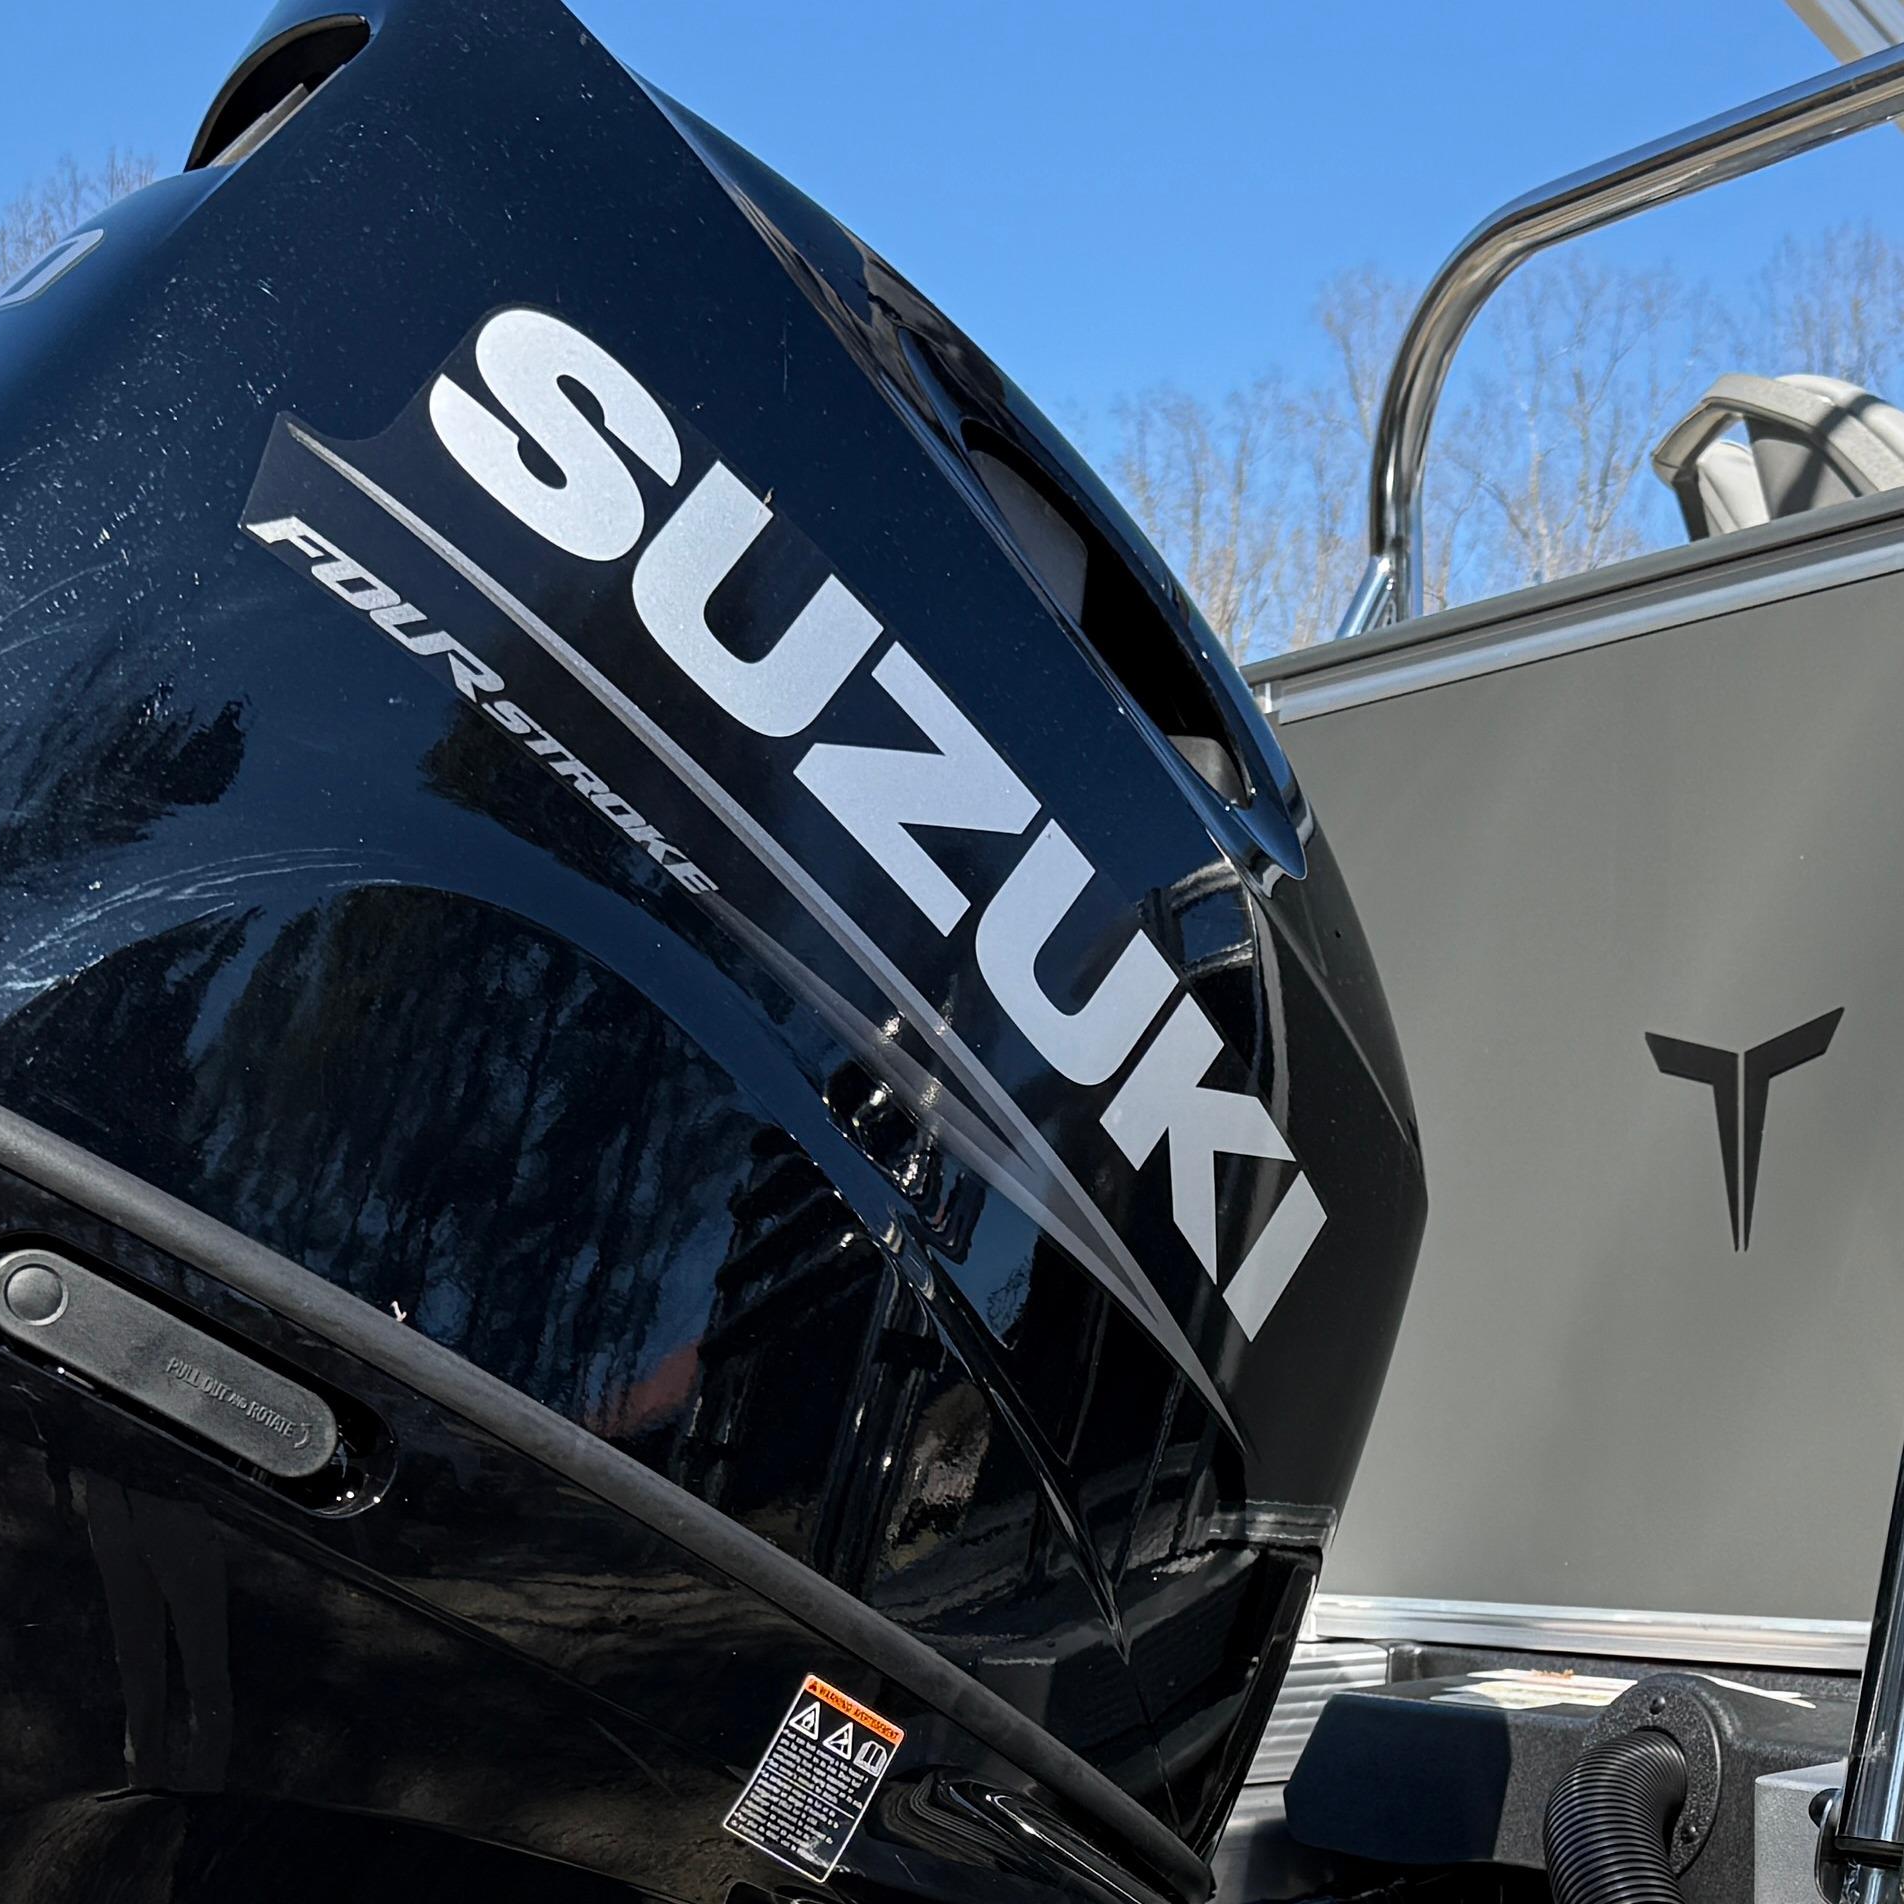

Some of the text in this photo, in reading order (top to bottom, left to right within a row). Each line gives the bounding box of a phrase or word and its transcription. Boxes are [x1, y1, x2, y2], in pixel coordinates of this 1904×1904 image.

[246, 515, 720, 894] FOUR STROKE
[429, 307, 1328, 1343] SUZUKI
[166, 1356, 201, 1388] PULL
[201, 1376, 232, 1400] OUT
[246, 1401, 295, 1438] ROTATE
